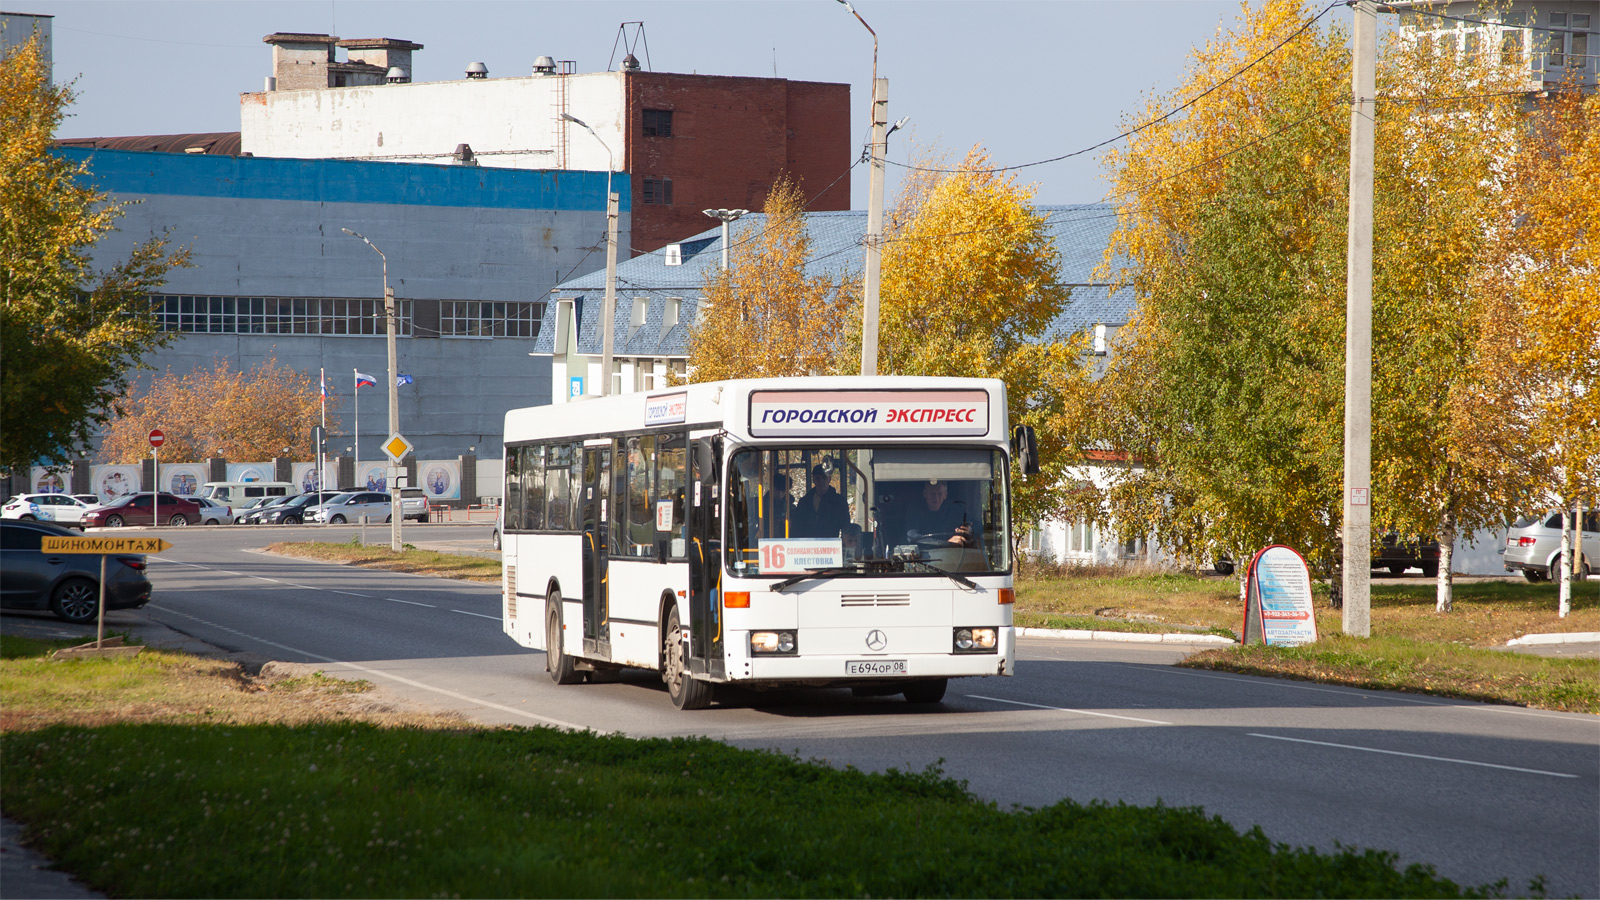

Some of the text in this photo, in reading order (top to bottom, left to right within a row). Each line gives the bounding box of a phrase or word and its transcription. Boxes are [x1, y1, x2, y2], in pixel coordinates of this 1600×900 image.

[761, 407, 977, 423] ГОРОДСКОЙ ЭКСПРЕСС
[47, 539, 158, 551] ШИНОМОНТАЖ
[760, 544, 786, 569] 16
[794, 557, 834, 565] КЛЕСТОВКА
[893, 662, 904, 670] 08
